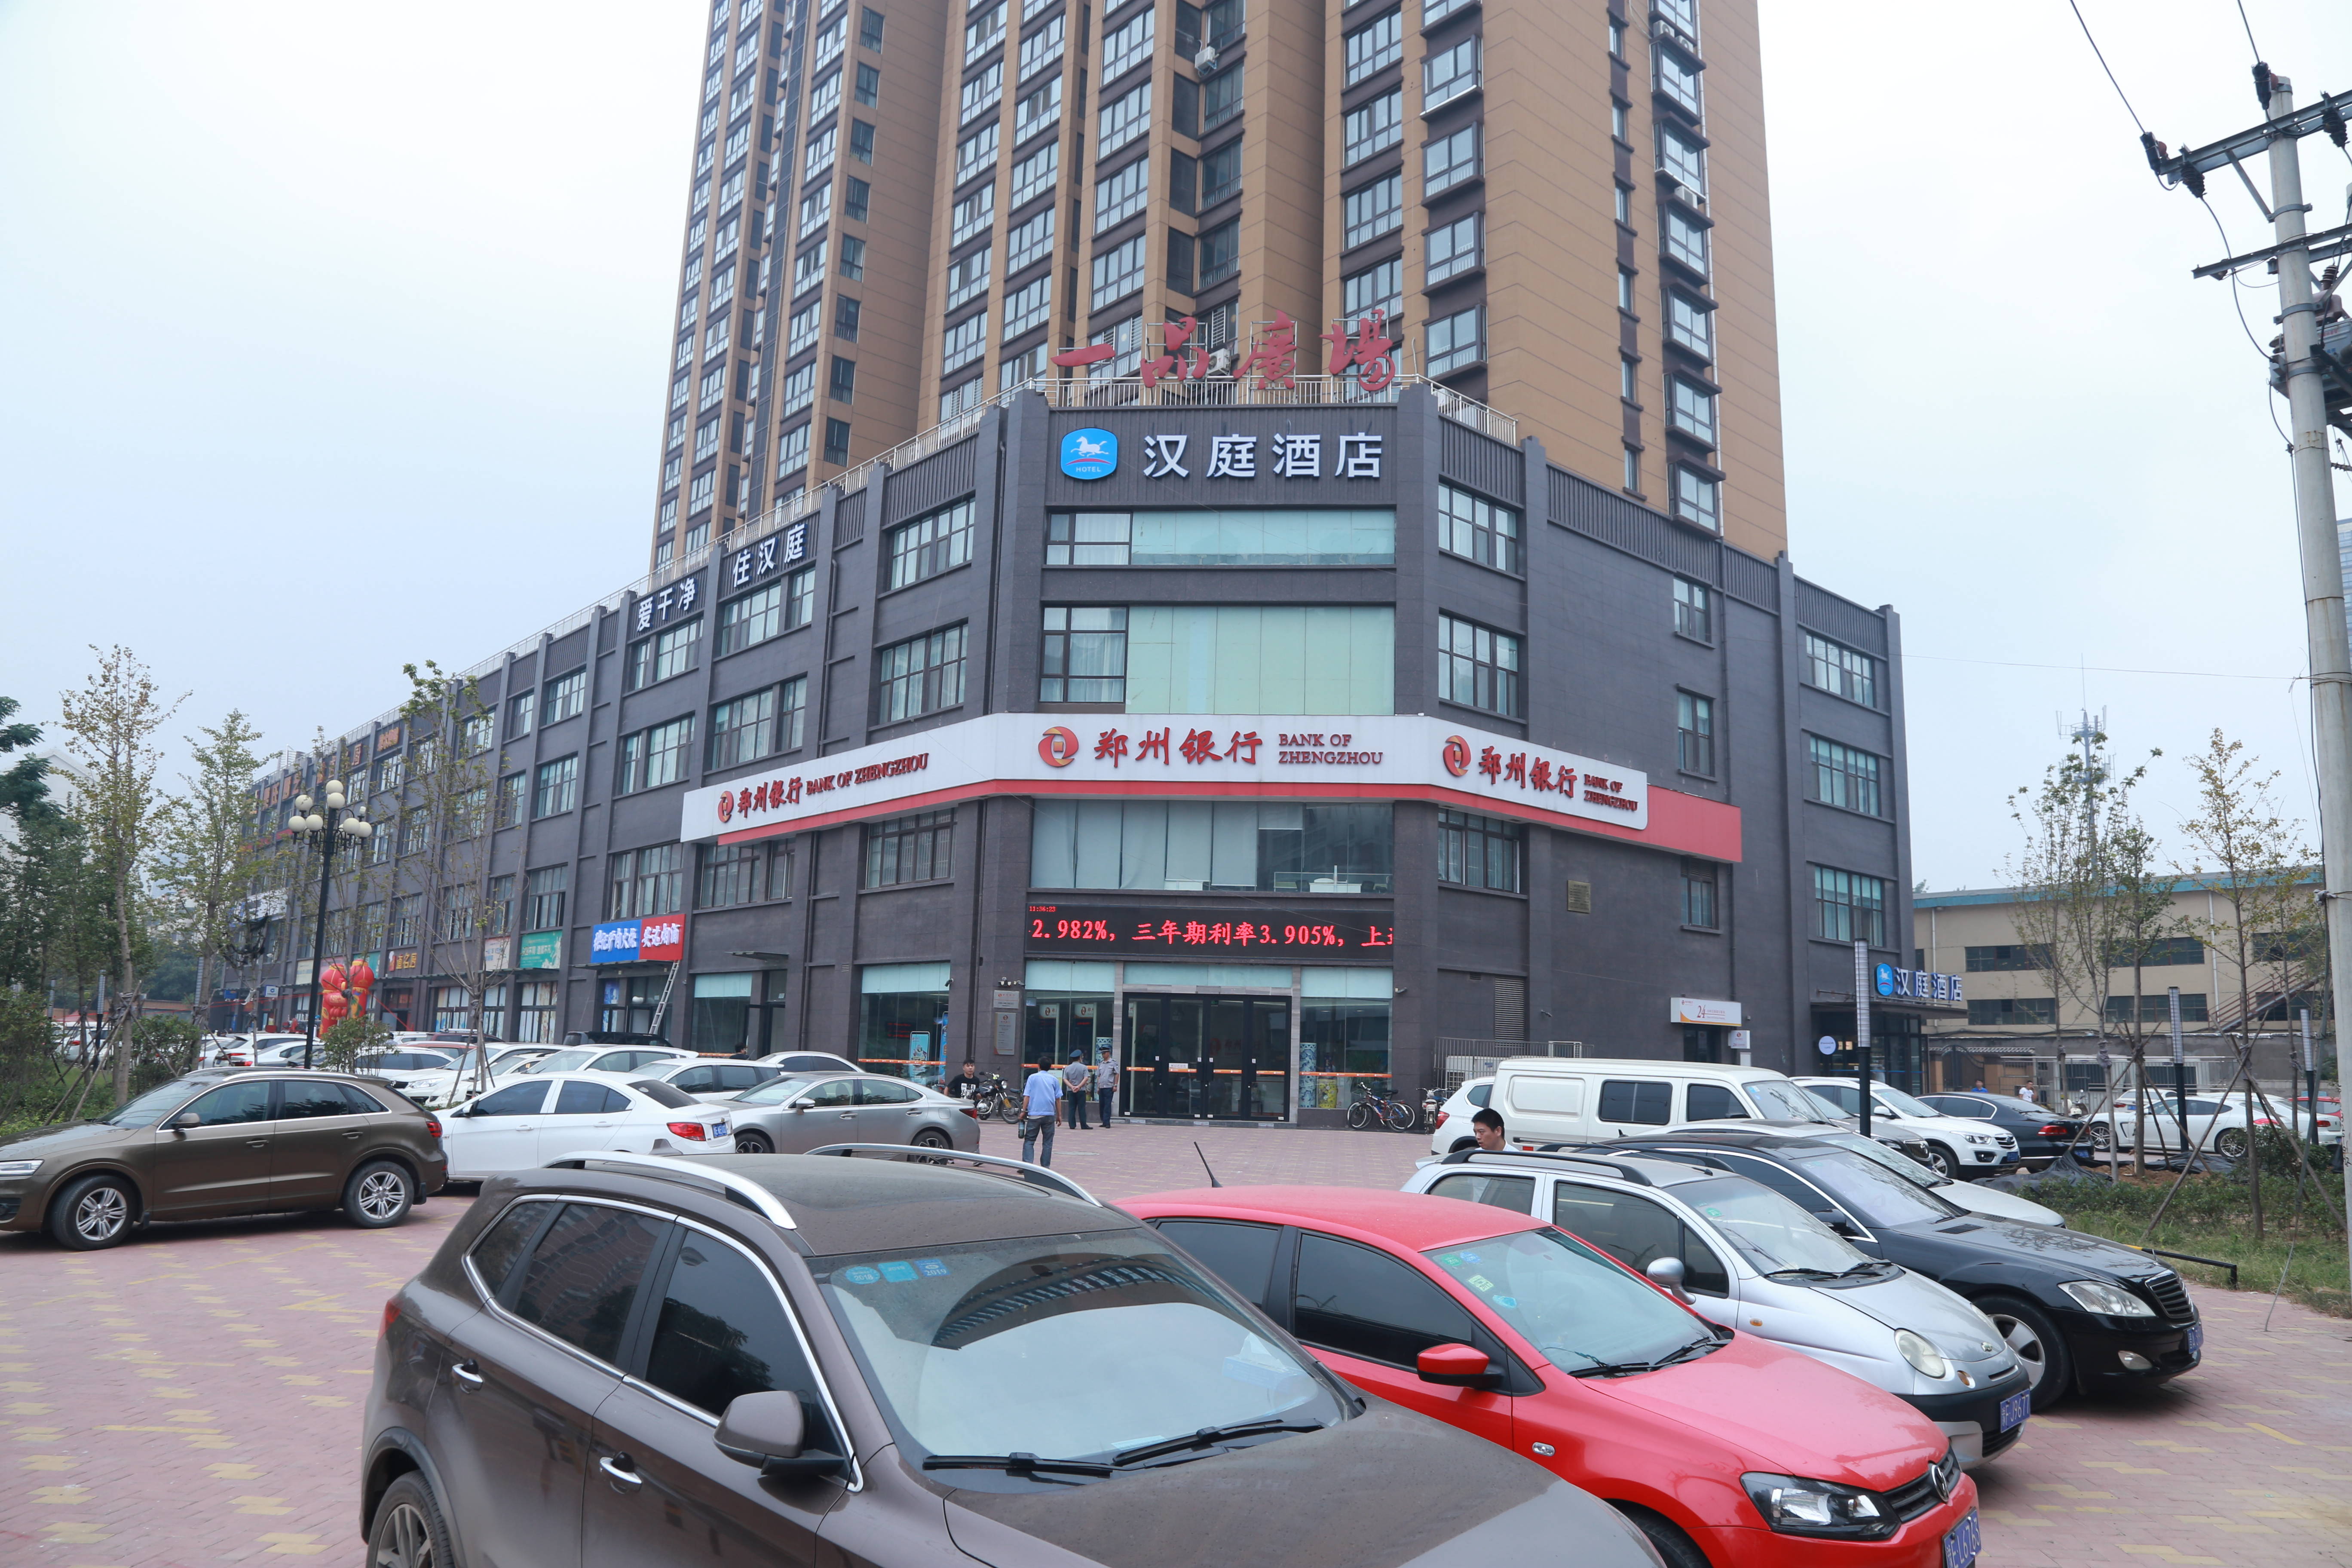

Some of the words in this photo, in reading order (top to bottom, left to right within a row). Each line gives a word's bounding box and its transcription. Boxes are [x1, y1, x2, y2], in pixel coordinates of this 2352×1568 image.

[1143, 432, 1382, 479] 汉庭酒店
[1093, 726, 1263, 768] 郑州银行
[1279, 733, 1323, 746] BANK
[1330, 733, 1352, 747] OF
[1278, 751, 1384, 765] ZHENGZHOU
[1479, 746, 1578, 798] 郑州银行
[737, 776, 801, 818] 郑州银行
[805, 774, 835, 795] BANK
[837, 770, 853, 787] OF
[854, 753, 929, 784] ZHENGZHOU
[1584, 774, 1609, 791] BANK
[1611, 781, 1623, 793] OF
[1584, 790, 1639, 812] ZHENGZHOU
[1894, 967, 1963, 1001] 汉庭酒店
[1697, 1004, 1706, 1018] 24
